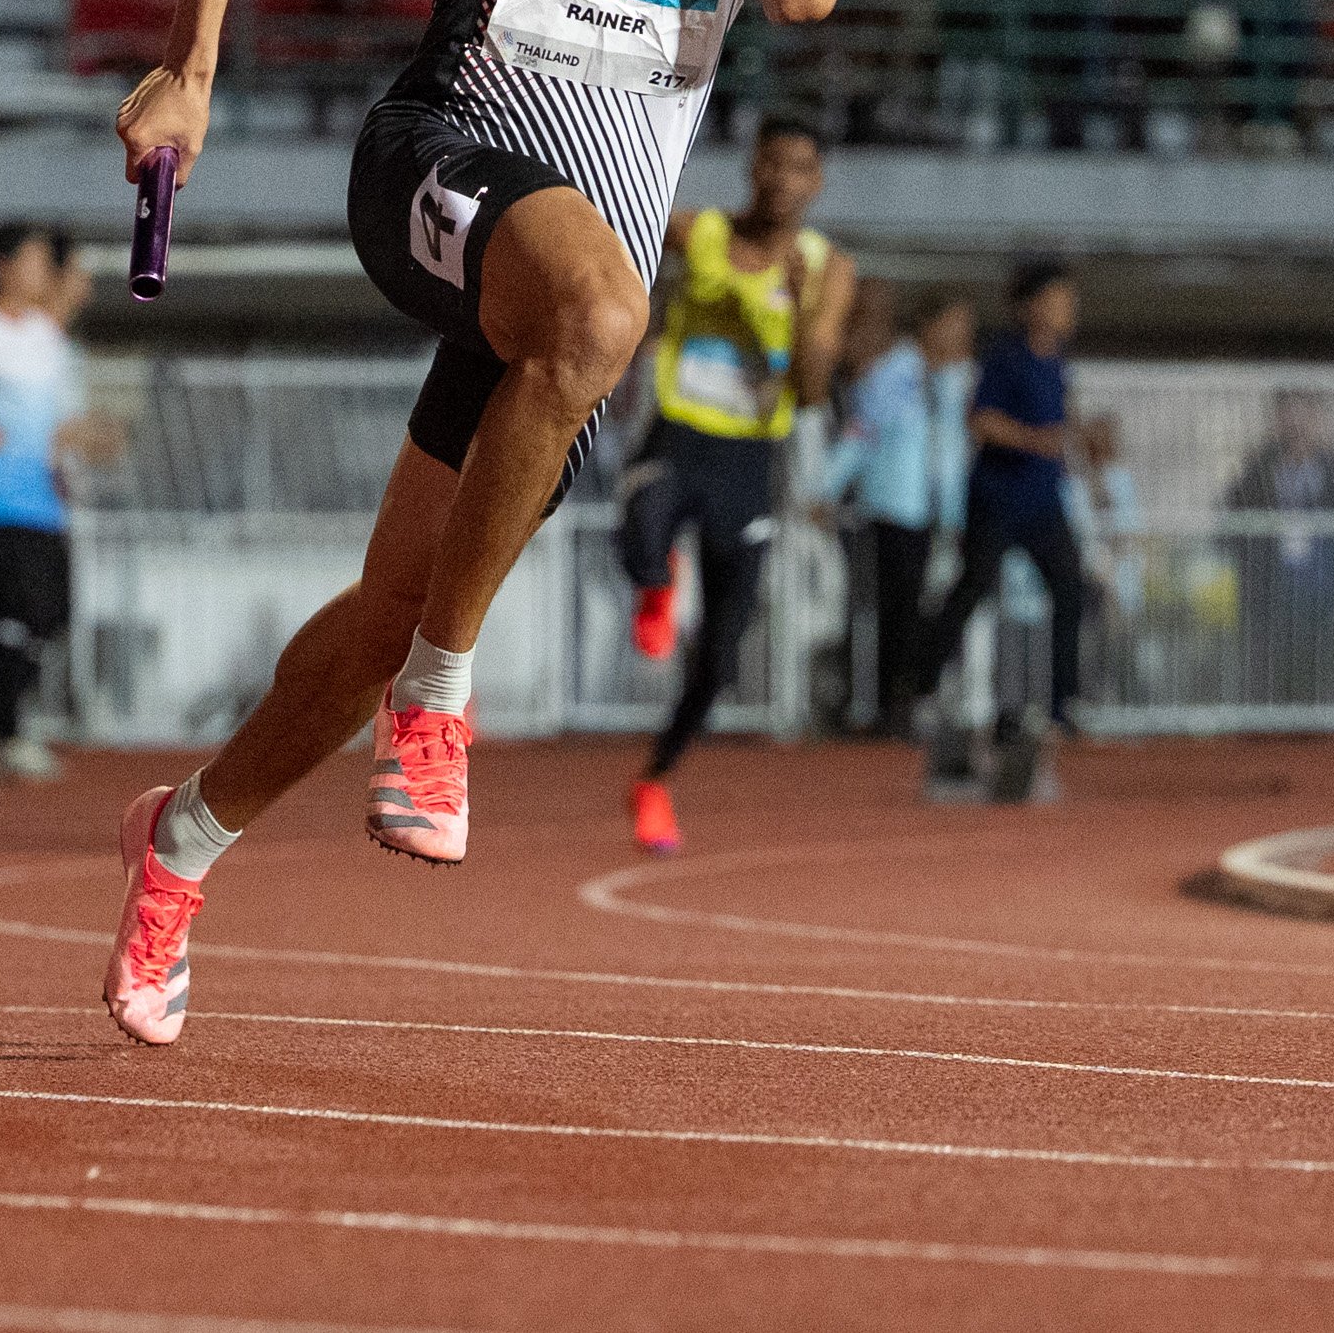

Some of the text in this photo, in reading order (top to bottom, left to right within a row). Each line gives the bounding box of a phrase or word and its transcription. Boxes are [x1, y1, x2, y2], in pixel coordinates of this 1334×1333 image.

[566, 3, 646, 35] RAINER
[516, 41, 580, 67] THAILAND
[648, 70, 686, 88] 217
[419, 190, 457, 263] 4
